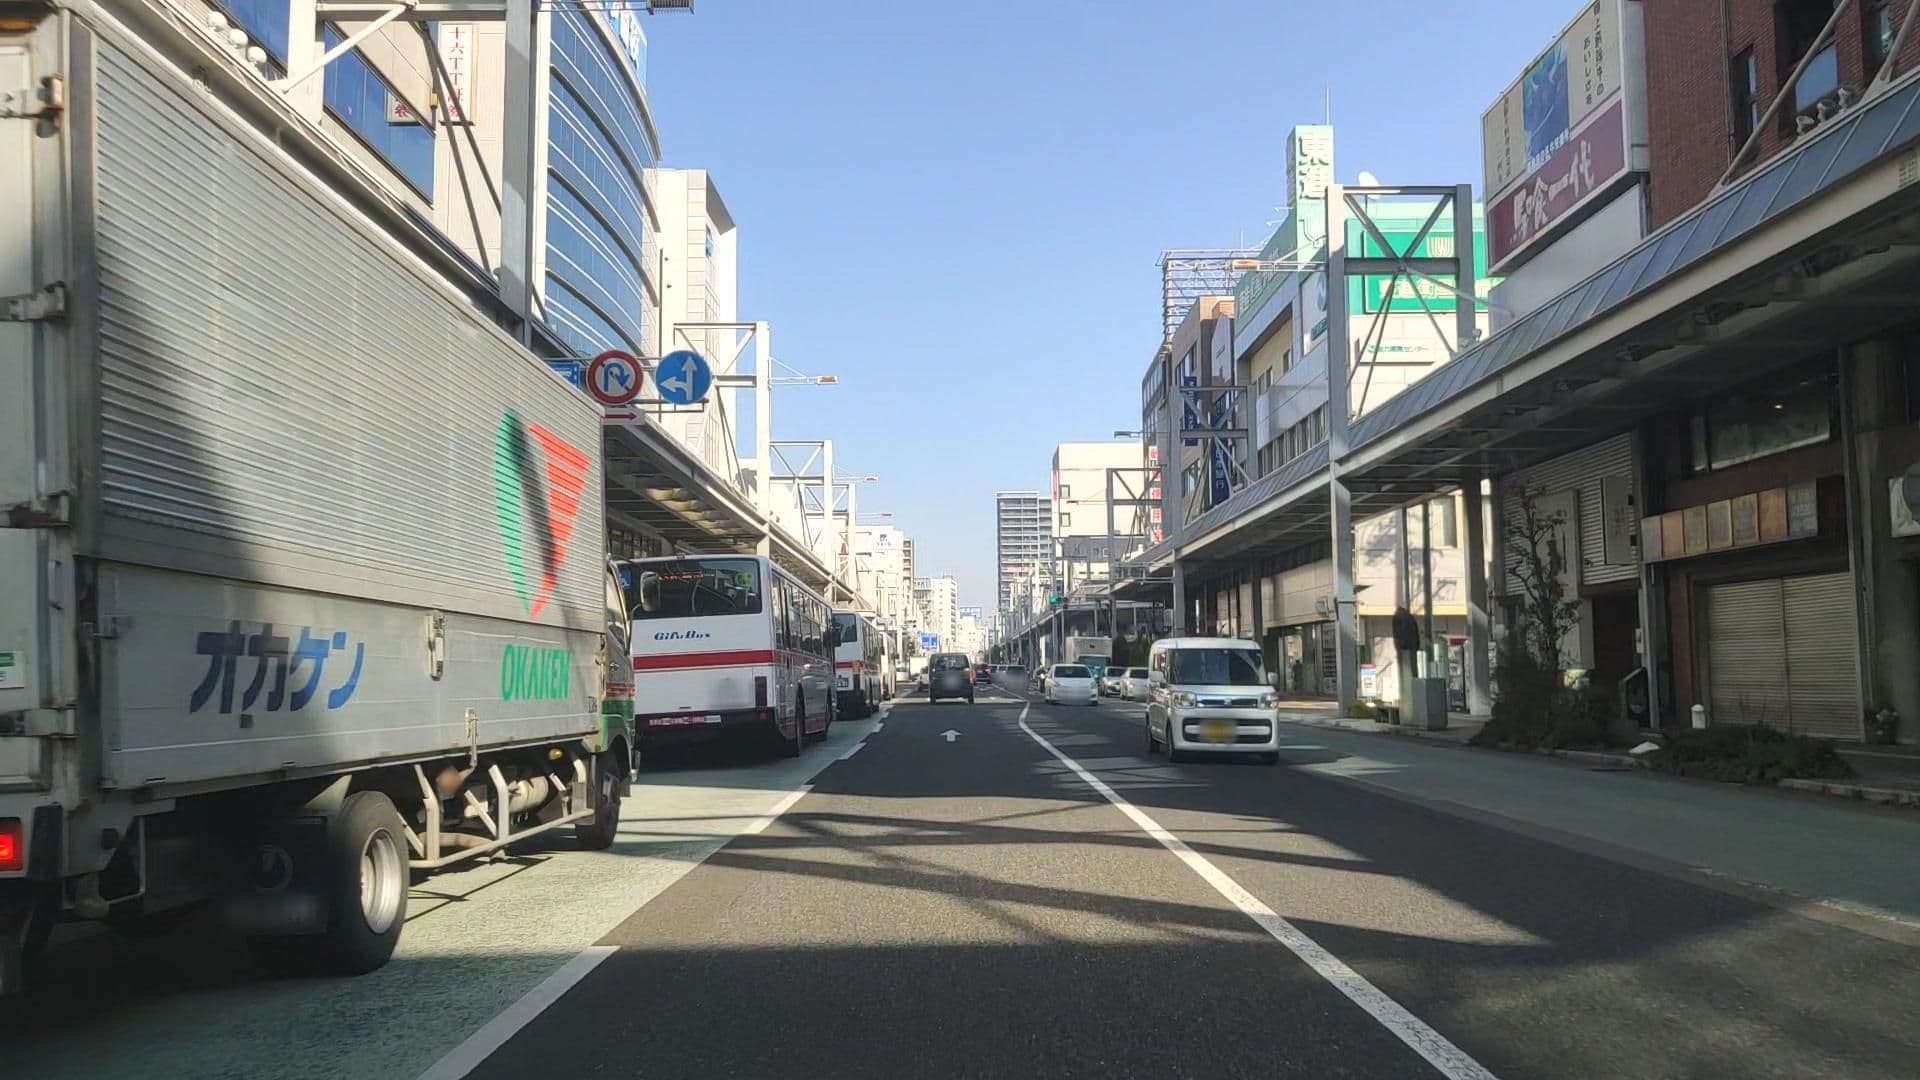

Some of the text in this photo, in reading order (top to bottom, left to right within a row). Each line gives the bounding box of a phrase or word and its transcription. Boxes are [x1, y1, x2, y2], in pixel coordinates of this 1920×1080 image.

[190, 620, 365, 714] オカケン
[501, 644, 572, 702] OKAKEN
